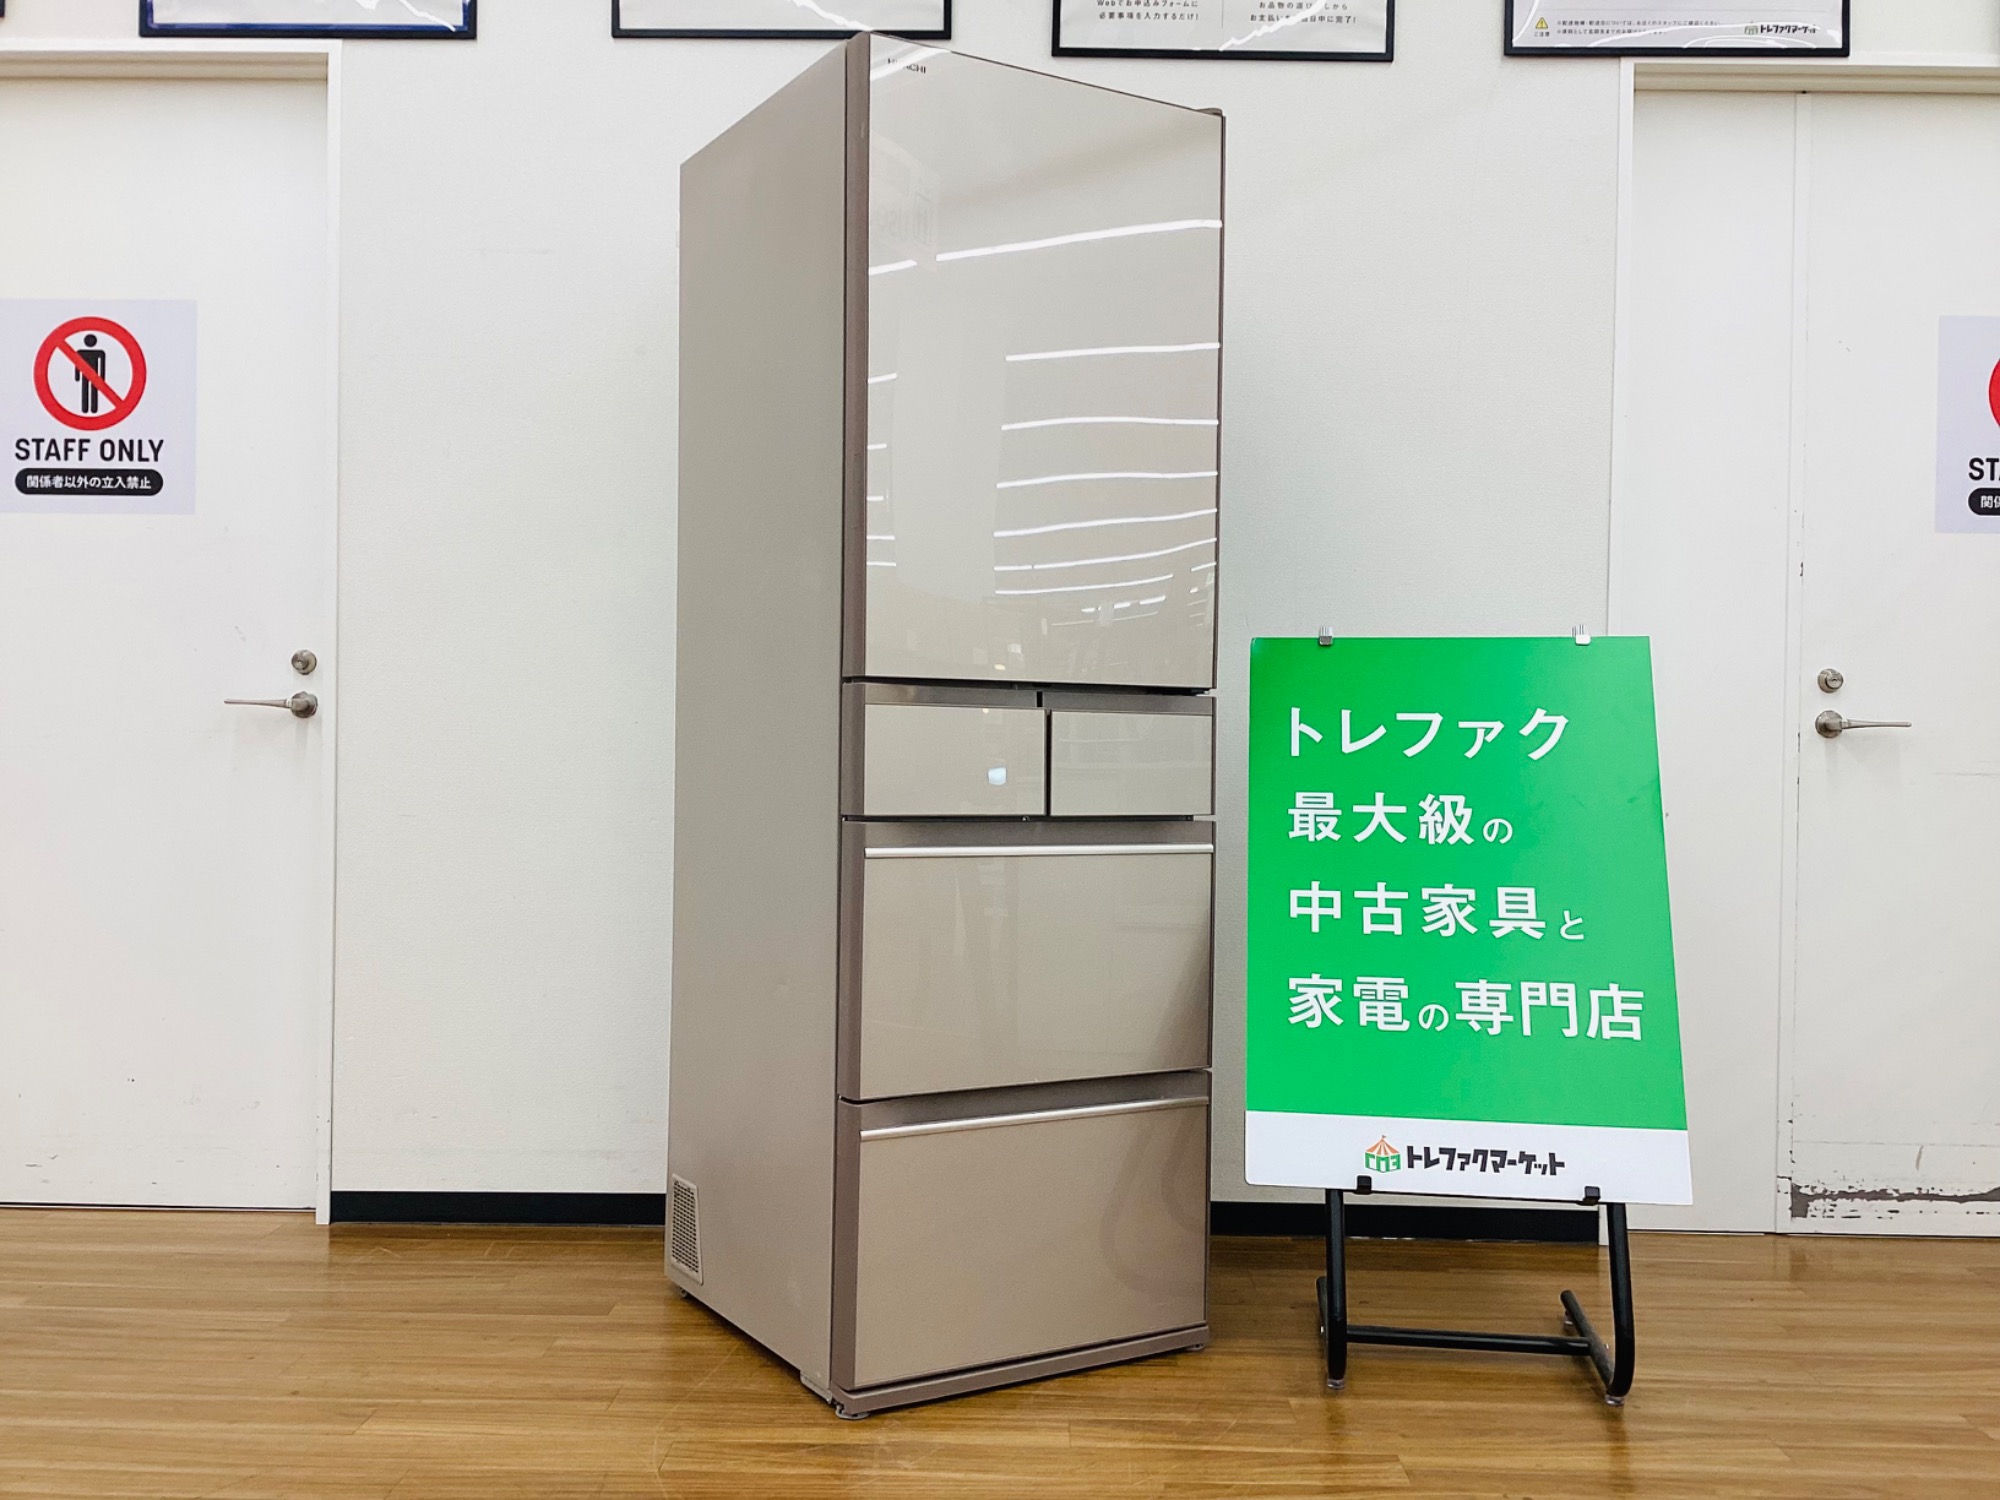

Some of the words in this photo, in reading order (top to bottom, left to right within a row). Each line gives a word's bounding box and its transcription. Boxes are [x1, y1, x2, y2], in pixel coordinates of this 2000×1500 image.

[15, 438, 91, 462] STAFF
[99, 438, 164, 463] ONLY
[1968, 457, 2000, 481] ST
[26, 474, 152, 490] 関係者以外の立入禁止
[1290, 706, 1570, 761] トレファク
[1287, 791, 1514, 846] 最大級の
[1289, 880, 1585, 941] 中古家具と
[1287, 973, 1645, 1042] 家電の専門店
[1406, 1145, 1566, 1176] トレファクマーケット
